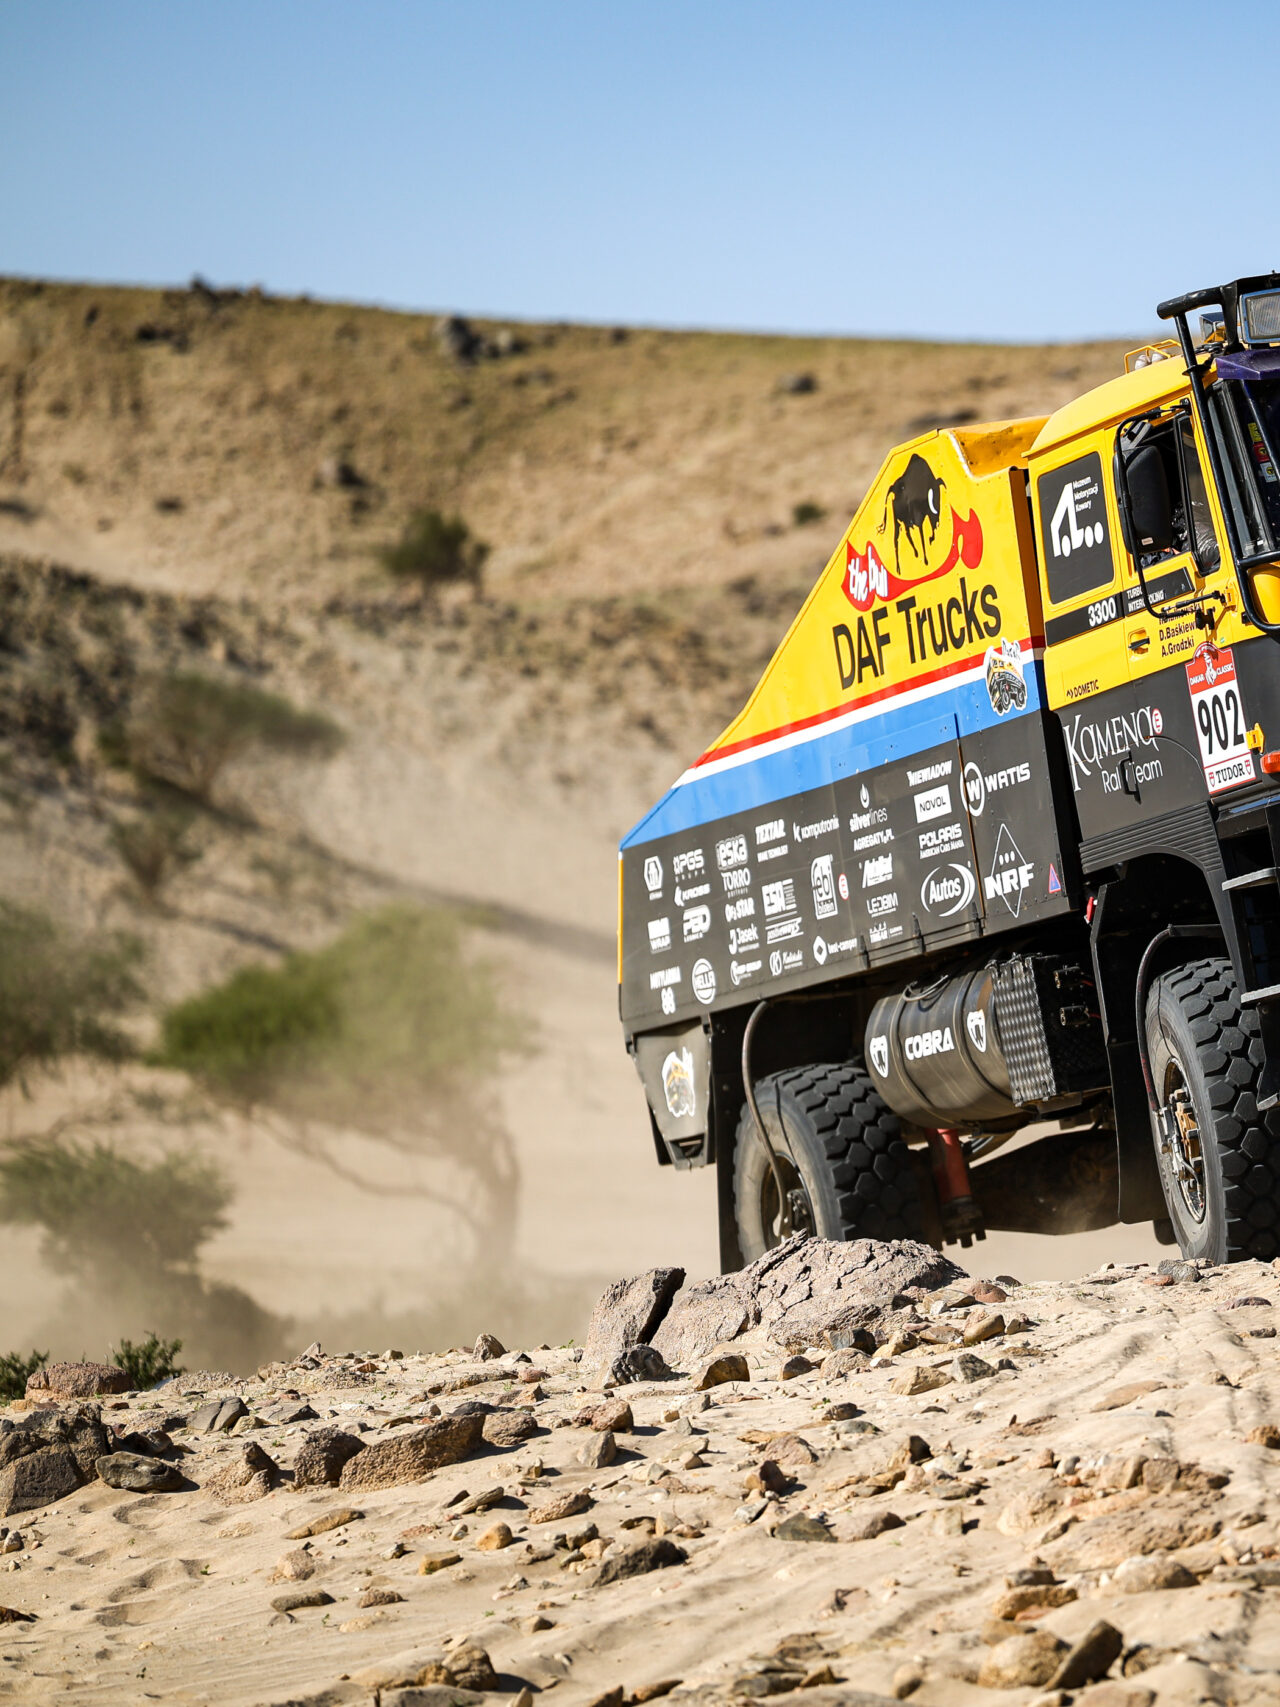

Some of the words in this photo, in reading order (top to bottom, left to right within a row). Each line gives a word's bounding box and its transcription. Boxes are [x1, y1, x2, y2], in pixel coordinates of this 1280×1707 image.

[848, 557, 868, 602] the
[868, 545, 888, 598] bull
[1127, 586, 1143, 600] TURB
[1088, 597, 1117, 627] 3300
[832, 606, 891, 691] DAF
[896, 576, 1002, 665] Trucks
[1161, 636, 1195, 657] A.Grodzki
[1074, 679, 1100, 698] DOMETIC
[1197, 689, 1245, 755] 902
[985, 762, 1031, 793] WATIS
[1216, 763, 1245, 784] TUDOR
[919, 796, 947, 813] NOVOL
[755, 819, 786, 845] TEXTAR
[849, 808, 888, 833] silverlines
[918, 823, 963, 849] POLARIS
[721, 868, 751, 891] TORRO
[929, 877, 962, 905] Autos
[984, 863, 1035, 901] NRF
[905, 1027, 954, 1061] COBRA
